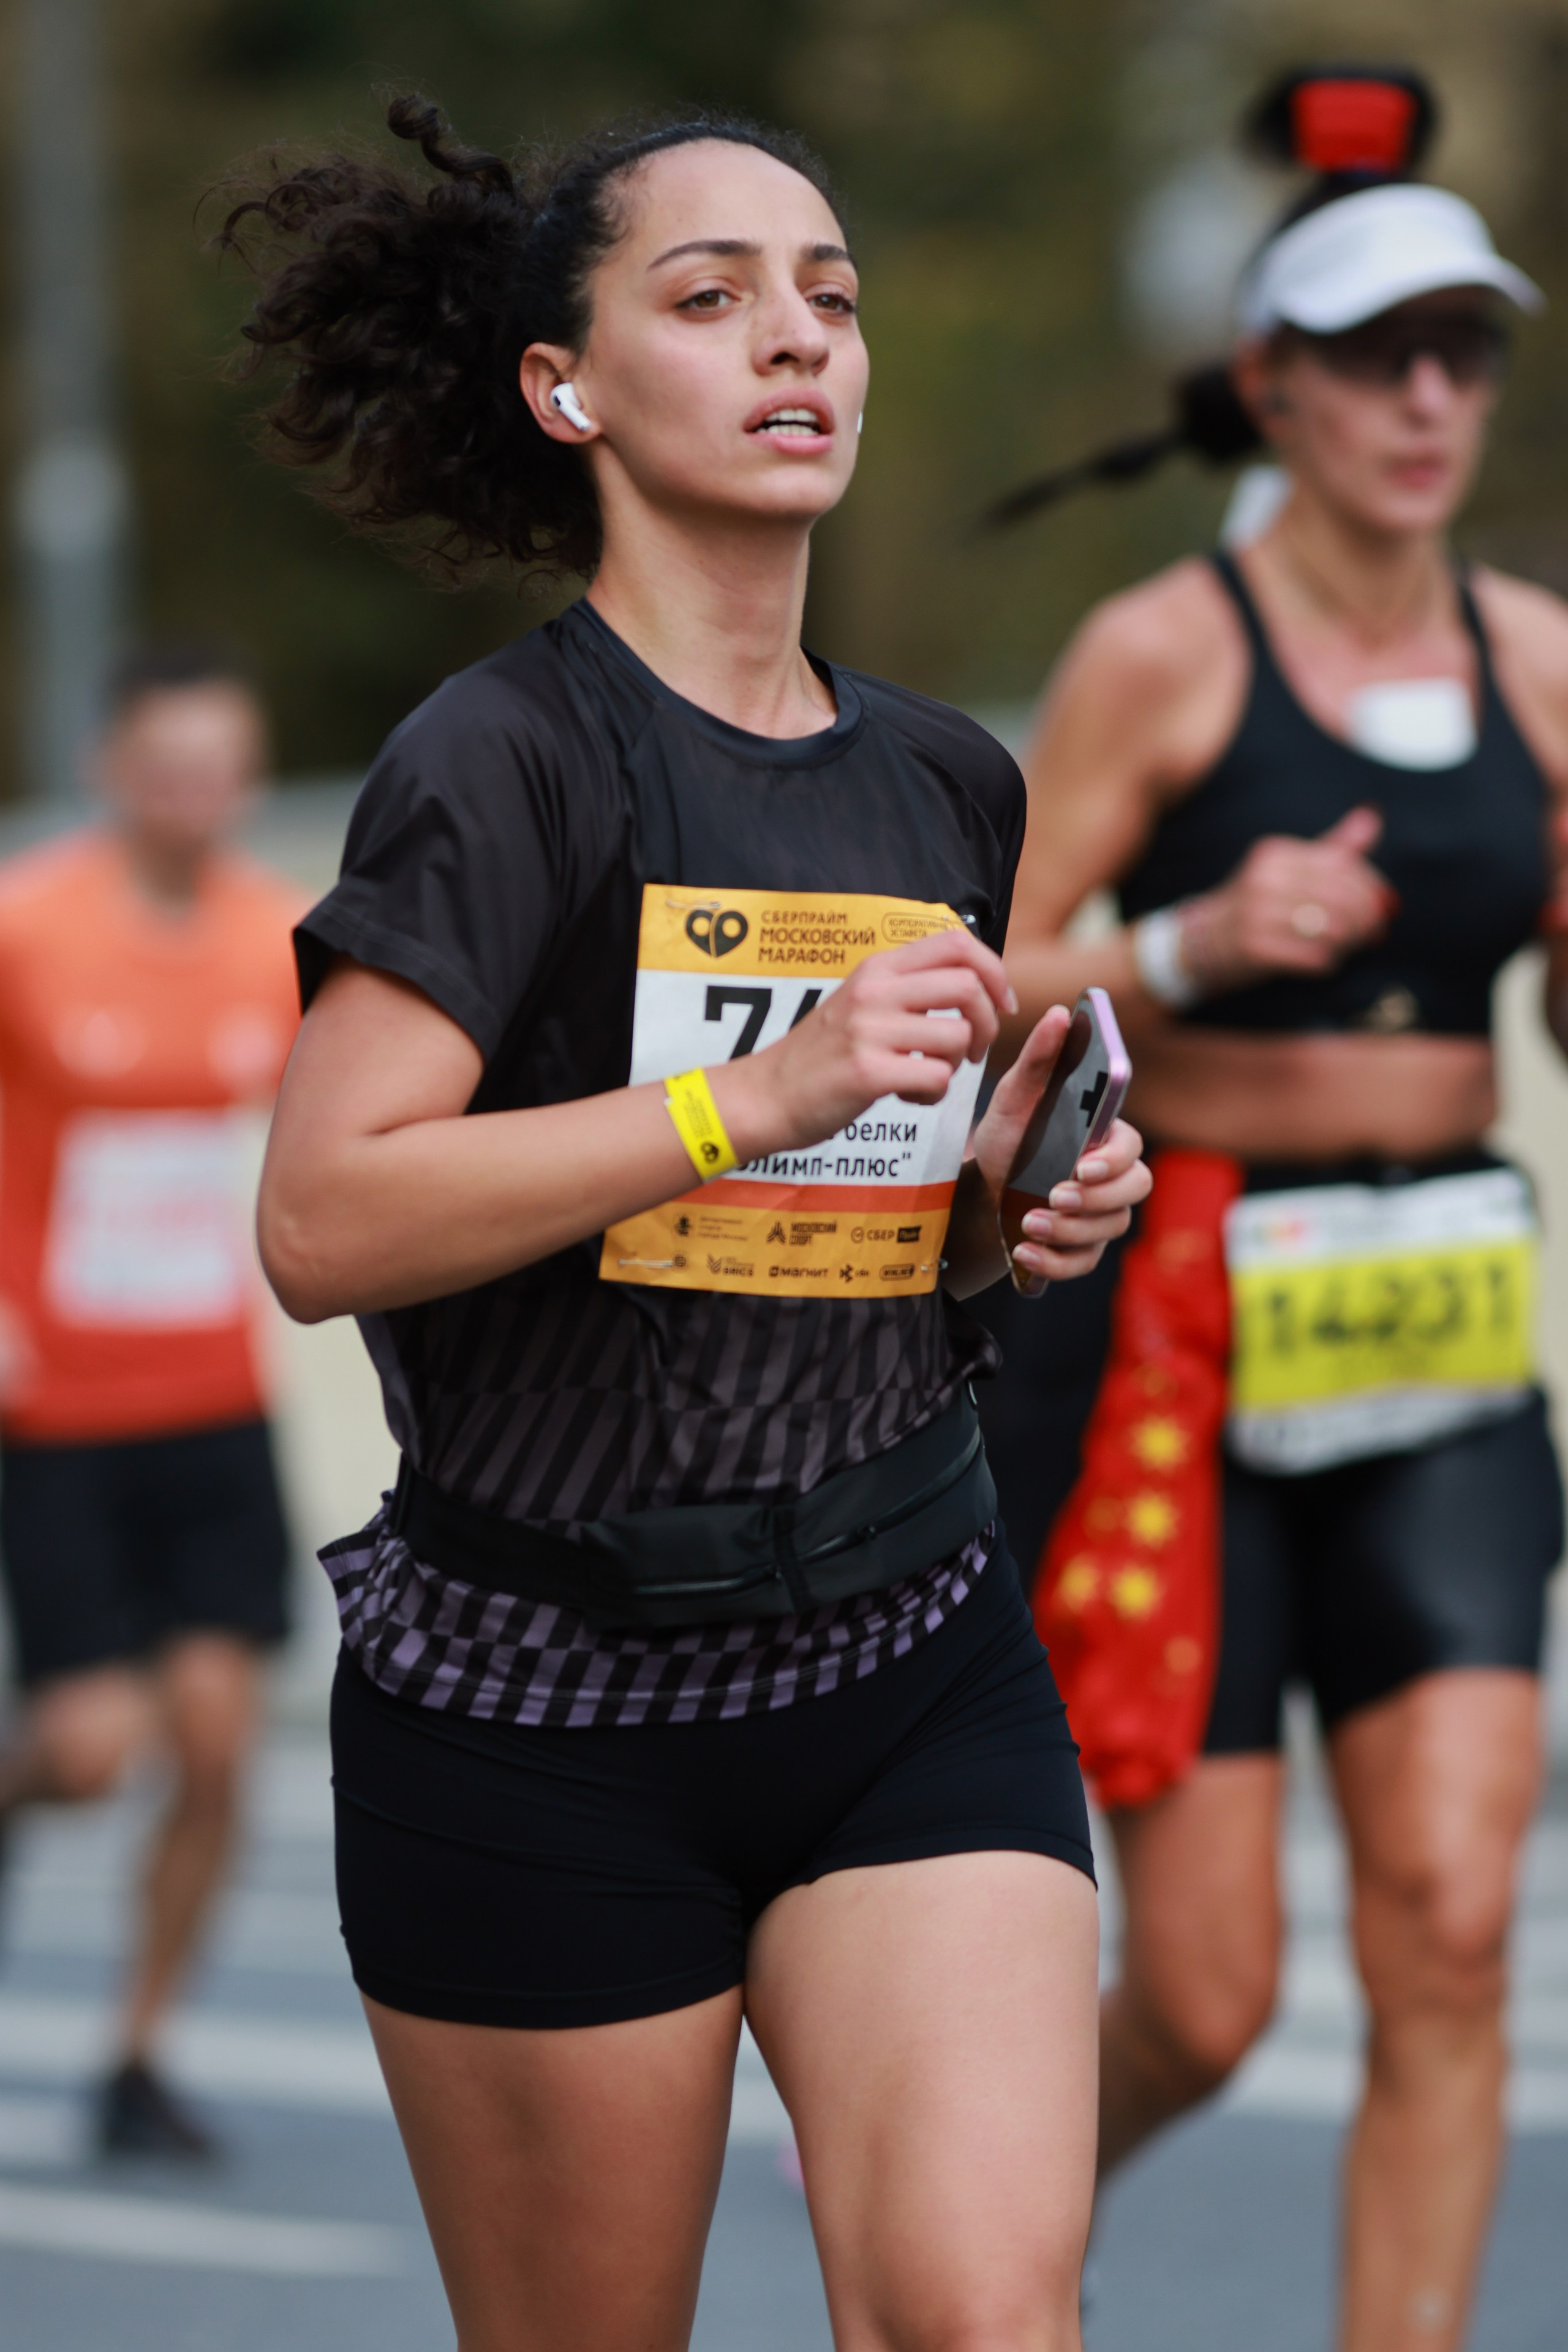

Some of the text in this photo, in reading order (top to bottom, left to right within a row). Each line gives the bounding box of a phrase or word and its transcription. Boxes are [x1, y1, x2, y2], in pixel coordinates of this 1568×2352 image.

[761, 909, 848, 925] СБЕРПРАЙМ
[760, 926, 876, 946] МОСКОВСКИЙ
[758, 947, 846, 965] МАРАФОН
[867, 1229, 895, 1241] СБЕР
